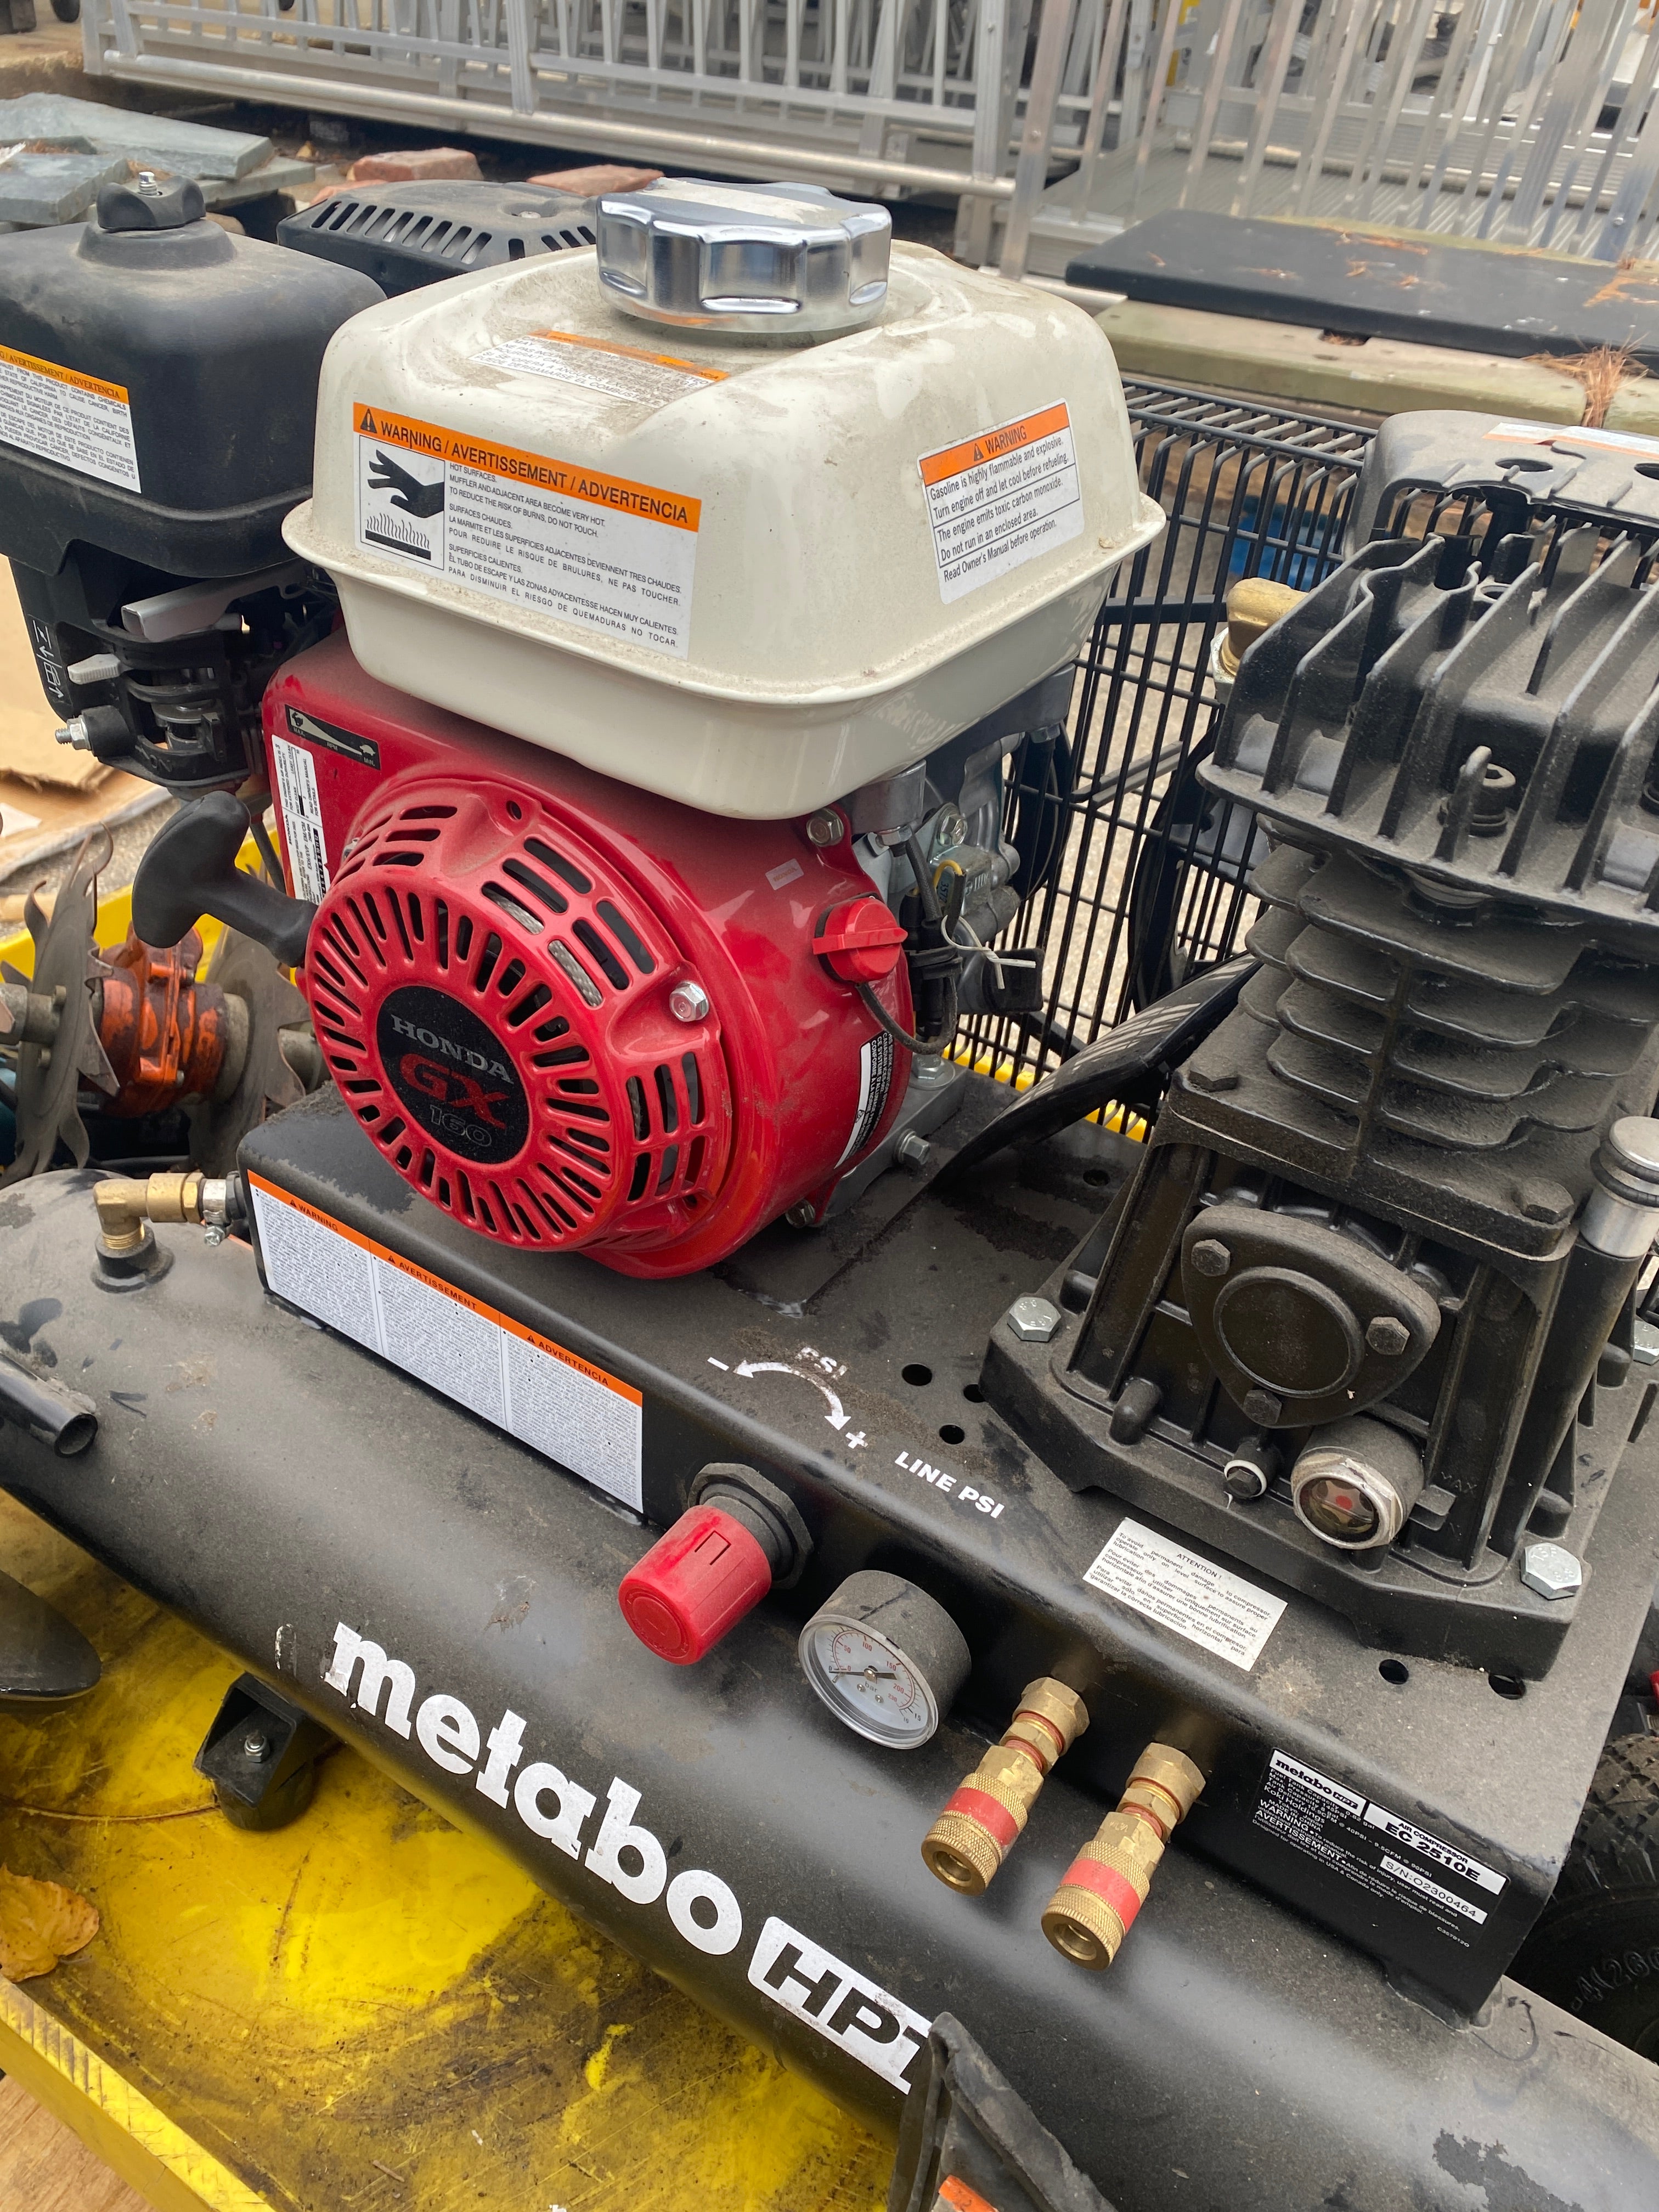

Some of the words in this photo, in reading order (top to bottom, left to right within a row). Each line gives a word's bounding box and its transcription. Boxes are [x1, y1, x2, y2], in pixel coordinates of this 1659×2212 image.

[9, 354, 64, 380] AVERTISSEMENT
[69, 375, 120, 399] ADVERTENCIA
[985, 425, 1026, 454] WARNING
[381, 421, 441, 450] WARNING
[444, 440, 449, 453] /
[451, 442, 567, 488] AVERTISSEMENT
[570, 476, 575, 490] /
[578, 479, 687, 523] ADVERTENCIA
[449, 462, 462, 472] HOT
[463, 466, 496, 482] SURFACES.
[930, 481, 960, 501] Gasoline
[960, 476, 967, 488] is
[967, 466, 988, 485] highly
[989, 452, 1022, 476] flammable
[1023, 445, 1035, 461] and
[1035, 436, 1063, 455] explosive.
[933, 504, 950, 520] Turn
[951, 495, 974, 512] engine
[975, 487, 984, 501] off
[985, 481, 997, 497] and
[998, 478, 1008, 492] let
[1008, 470, 1022, 487] cool
[1022, 463, 1041, 482] before
[1042, 453, 1069, 471] refueling.
[449, 473, 477, 489] MUFFLER
[477, 483, 492, 493] AND
[491, 487, 524, 503] ADJACENT
[524, 496, 542, 508] AREA
[543, 502, 571, 517] BECOME
[572, 510, 589, 522] VERY
[590, 516, 605, 527] HOT.
[449, 486, 458, 494] TO
[458, 489, 483, 503] REDUCE
[484, 496, 496, 507] THE
[497, 500, 512, 511] RISK
[512, 505, 522, 514] OF
[522, 509, 546, 523] BURNS,
[548, 516, 557, 525] DO
[558, 519, 573, 529] NOT
[573, 523, 598, 537] TOUCH.
[449, 503, 481, 519] SURFACES
[481, 513, 512, 529] CHAUDES.
[936, 528, 951, 542] The
[952, 517, 975, 535] engine
[976, 508, 994, 524] emits
[995, 499, 1011, 516] toxic
[1012, 491, 1033, 508] carbon
[1034, 476, 1063, 498] monoxide.
[449, 515, 456, 523] LA
[457, 517, 483, 532] MARMITE
[484, 526, 492, 534] ET
[492, 528, 504, 538] LES
[504, 532, 544, 551] SUPERFICIES
[544, 545, 586, 564] ADJACENTES
[586, 557, 628, 577] DEVIENNENT
[629, 571, 646, 583] TRES
[647, 577, 681, 593] CHAUDES.
[940, 549, 951, 561] Do
[952, 541, 964, 556] not
[964, 537, 976, 550] run
[977, 532, 984, 544] in
[985, 528, 993, 540] an
[994, 512, 1022, 535] enclosed
[1023, 508, 1038, 522] area.
[943, 563, 961, 582] Read
[961, 551, 986, 573] Owner's
[987, 539, 1009, 561] Manual
[1009, 532, 1029, 549] before
[1029, 519, 1057, 540] operation.
[449, 543, 487, 561] SUPERFICIES
[488, 556, 522, 573] CALIENTES.
[449, 527, 467, 539] POUR
[471, 534, 501, 550] REDUIRE
[505, 545, 514, 554] LE
[518, 549, 544, 563] RISQUE
[548, 558, 557, 568] DE
[562, 562, 602, 583] BRULURES,
[608, 577, 618, 587] NE
[622, 582, 636, 592] PAS
[641, 588, 680, 606] TOUCHER.
[448, 555, 456, 563] EL
[456, 557, 473, 568] TUBO
[473, 563, 482, 572] DE
[483, 566, 507, 580] ESCAPE
[514, 576, 525, 586] LAS
[526, 580, 547, 593] ZONAS
[548, 588, 599, 610] ADYACENTESSE
[599, 603, 622, 617] HACEN
[623, 612, 639, 622] MUY
[639, 617, 678, 635] CALIENTES.
[448, 566, 465, 578] PARA
[470, 573, 506, 591] DISMINUIR
[511, 587, 520, 596] EL
[524, 591, 552, 606] RIESGO
[557, 602, 567, 612] DE
[572, 607, 625, 631] QUEMADURAS
[631, 626, 642, 636] NO
[648, 631, 677, 647] TOCAR.
[327, 742, 338, 751] RPM
[284, 814, 292, 845] HONDA
[391, 1014, 514, 1084] HONDA
[400, 1053, 510, 1129] GX
[430, 1104, 492, 1147] 160
[297, 1204, 338, 1231] WARNING
[399, 1262, 477, 1310] AVERTISSEMENT
[539, 1341, 608, 1385] ADVERTENCIA
[795, 1347, 848, 1380] PSI
[895, 1452, 957, 1492] LINE
[957, 1486, 1005, 1519] PSI
[1127, 1537, 1144, 1548] avoid
[1150, 1550, 1183, 1570] permanent
[1190, 1572, 1220, 1589] damage
[1233, 1595, 1271, 1618] compressor.
[1176, 1553, 1217, 1577] ATTENTION
[862, 1641, 872, 1651] 100
[887, 1661, 896, 1671] 150
[865, 1681, 877, 1692] bar
[888, 1694, 897, 1702] 230
[893, 1683, 904, 1694] 200
[324, 1622, 742, 1956] metabo
[1263, 1785, 1284, 1800] Koki
[1285, 1796, 1325, 1823] Holdings
[1275, 1759, 1332, 1795] metabo
[1332, 1791, 1358, 1809] HPT
[1255, 1809, 1342, 1861] AVERTISSEMENT
[1260, 1799, 1308, 1831] WARNING
[1268, 1799, 1289, 1813] MADE
[1289, 1810, 1298, 1818] IN
[1299, 1816, 1321, 1832] CHINA
[1385, 1821, 1412, 1842] EC
[1415, 1841, 1480, 1881] 2510E
[1398, 1822, 1412, 1832] AIR
[1413, 1830, 1468, 1864] COMPRESSOR
